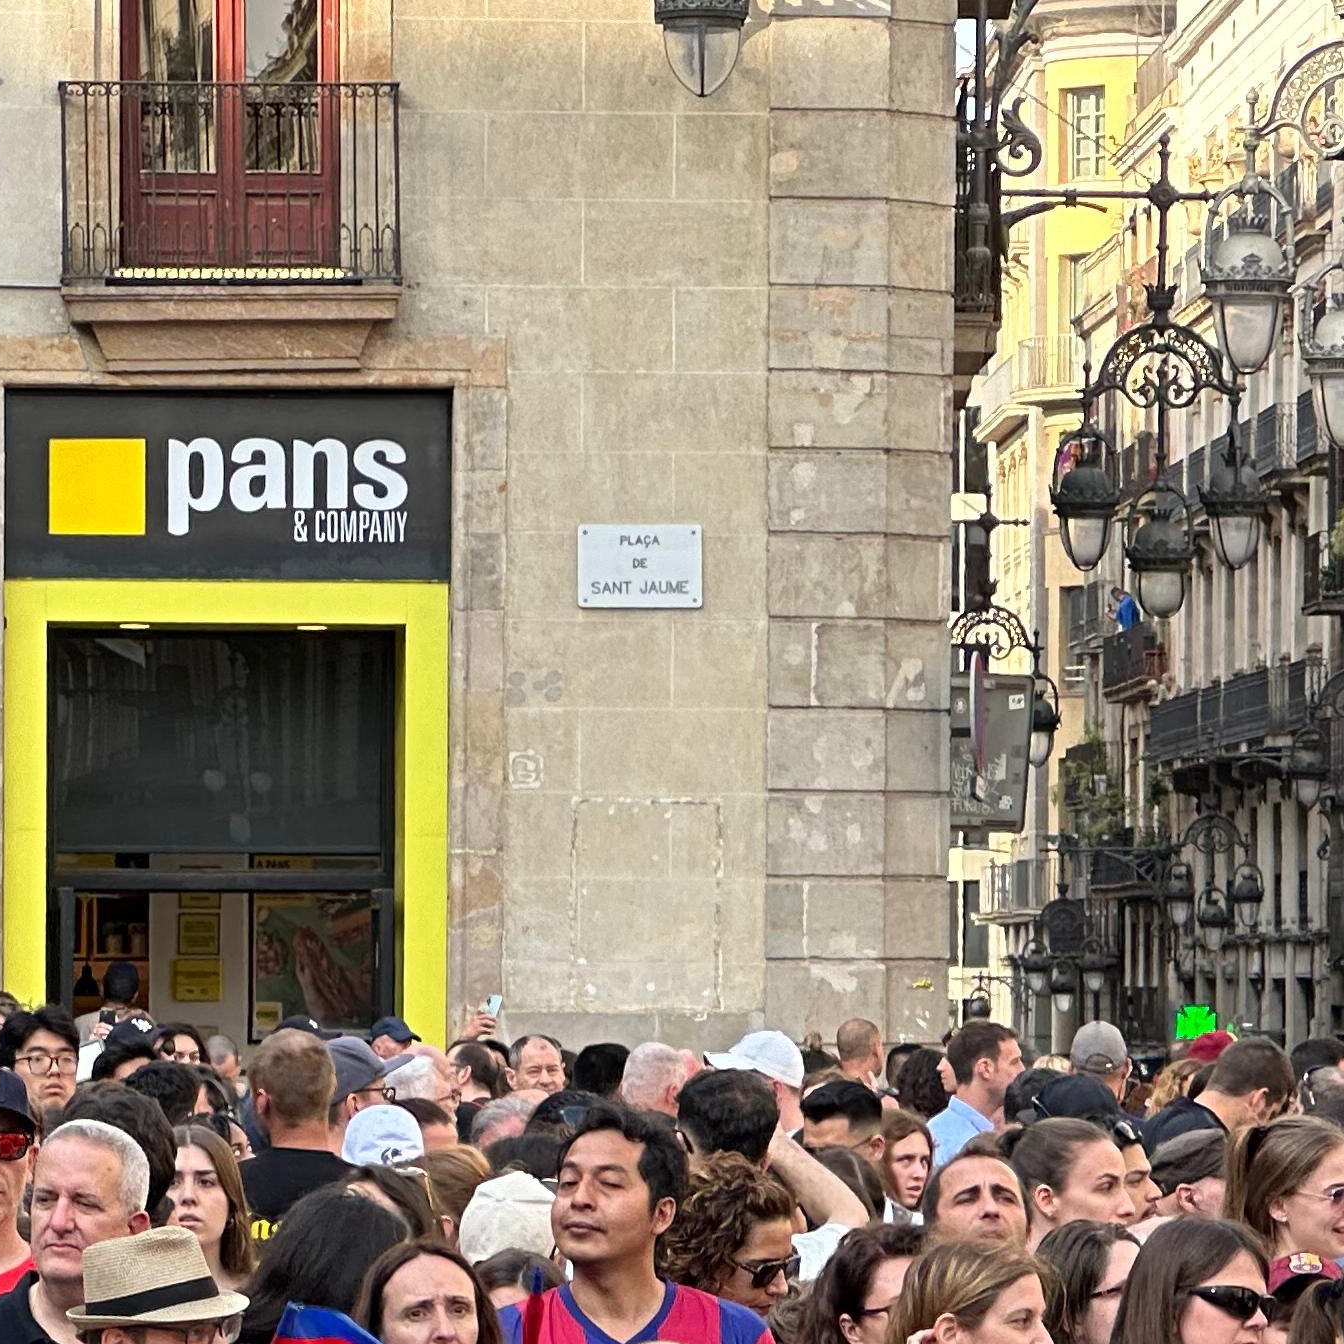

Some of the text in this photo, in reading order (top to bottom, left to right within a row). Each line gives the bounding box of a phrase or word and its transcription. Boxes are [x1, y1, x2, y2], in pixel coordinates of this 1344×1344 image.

[167, 437, 409, 537] pans
[293, 510, 409, 543] & COMPANY
[619, 535, 660, 549] PLAÇA
[632, 558, 648, 569] DE
[591, 580, 689, 594] SANT JAUME
